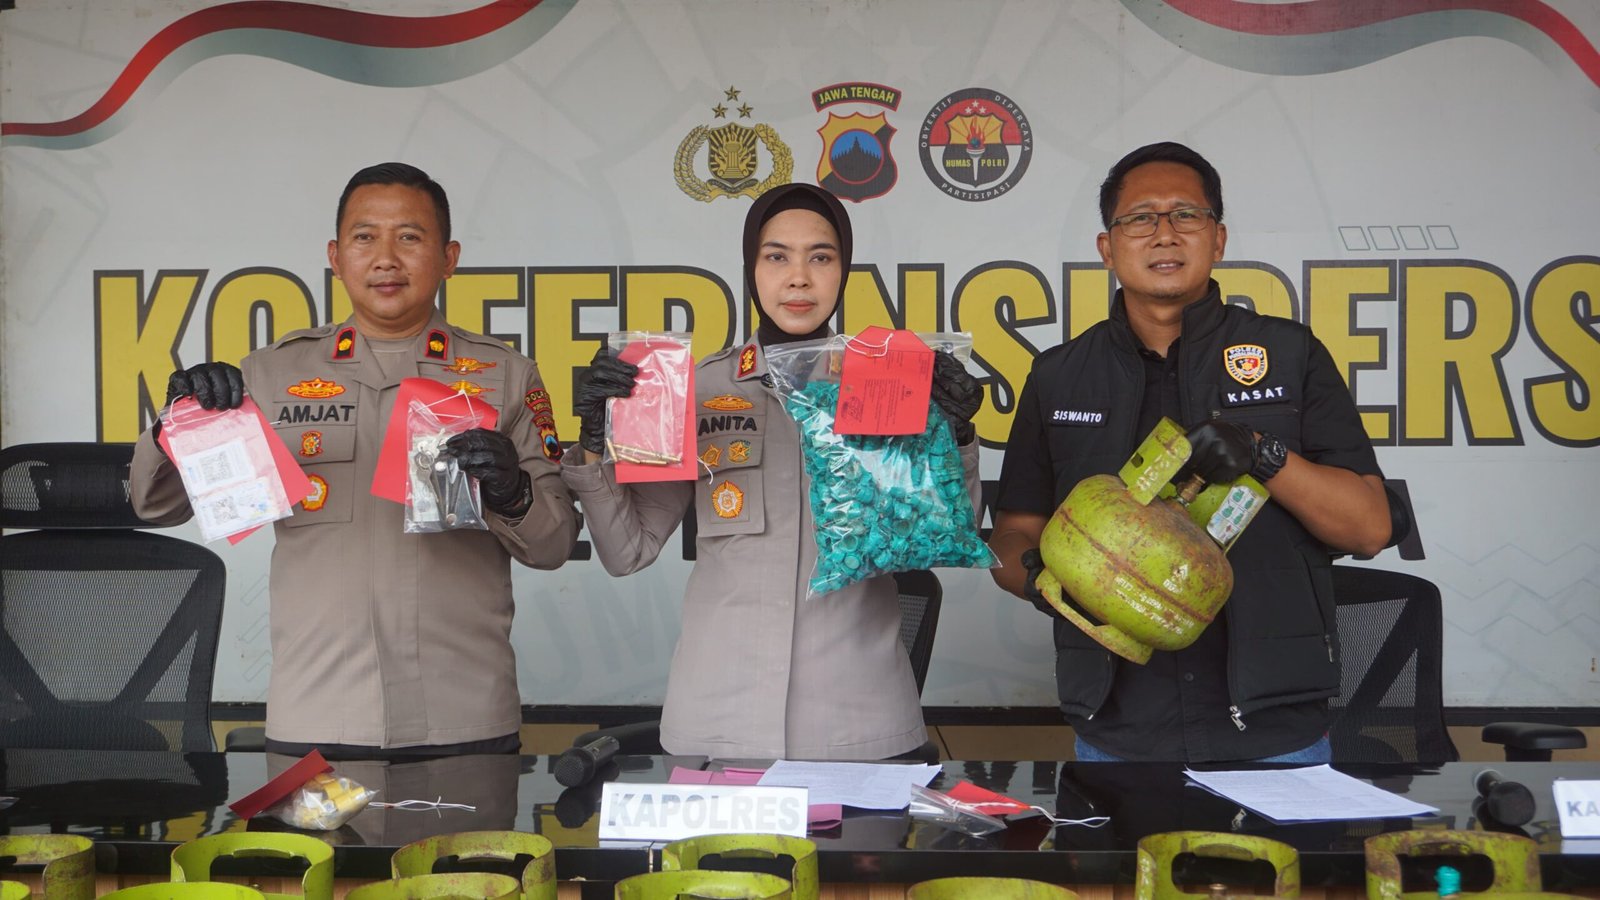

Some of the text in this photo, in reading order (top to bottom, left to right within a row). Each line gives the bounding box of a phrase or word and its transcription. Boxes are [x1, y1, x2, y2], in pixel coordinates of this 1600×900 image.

[819, 87, 895, 104] JAWA TENGAH
[921, 97, 952, 148] OBYEKTIF
[995, 95, 1031, 152] DIPERCAYA
[945, 159, 1006, 167] HUMAS POLRI
[941, 182, 1011, 200] PARTISIPASI
[1227, 386, 1283, 403] KASAT
[278, 405, 355, 425] AMJAT
[1053, 410, 1102, 423] SISWANTO
[698, 415, 757, 436] ANITA
[608, 792, 800, 832] KAPOLRES
